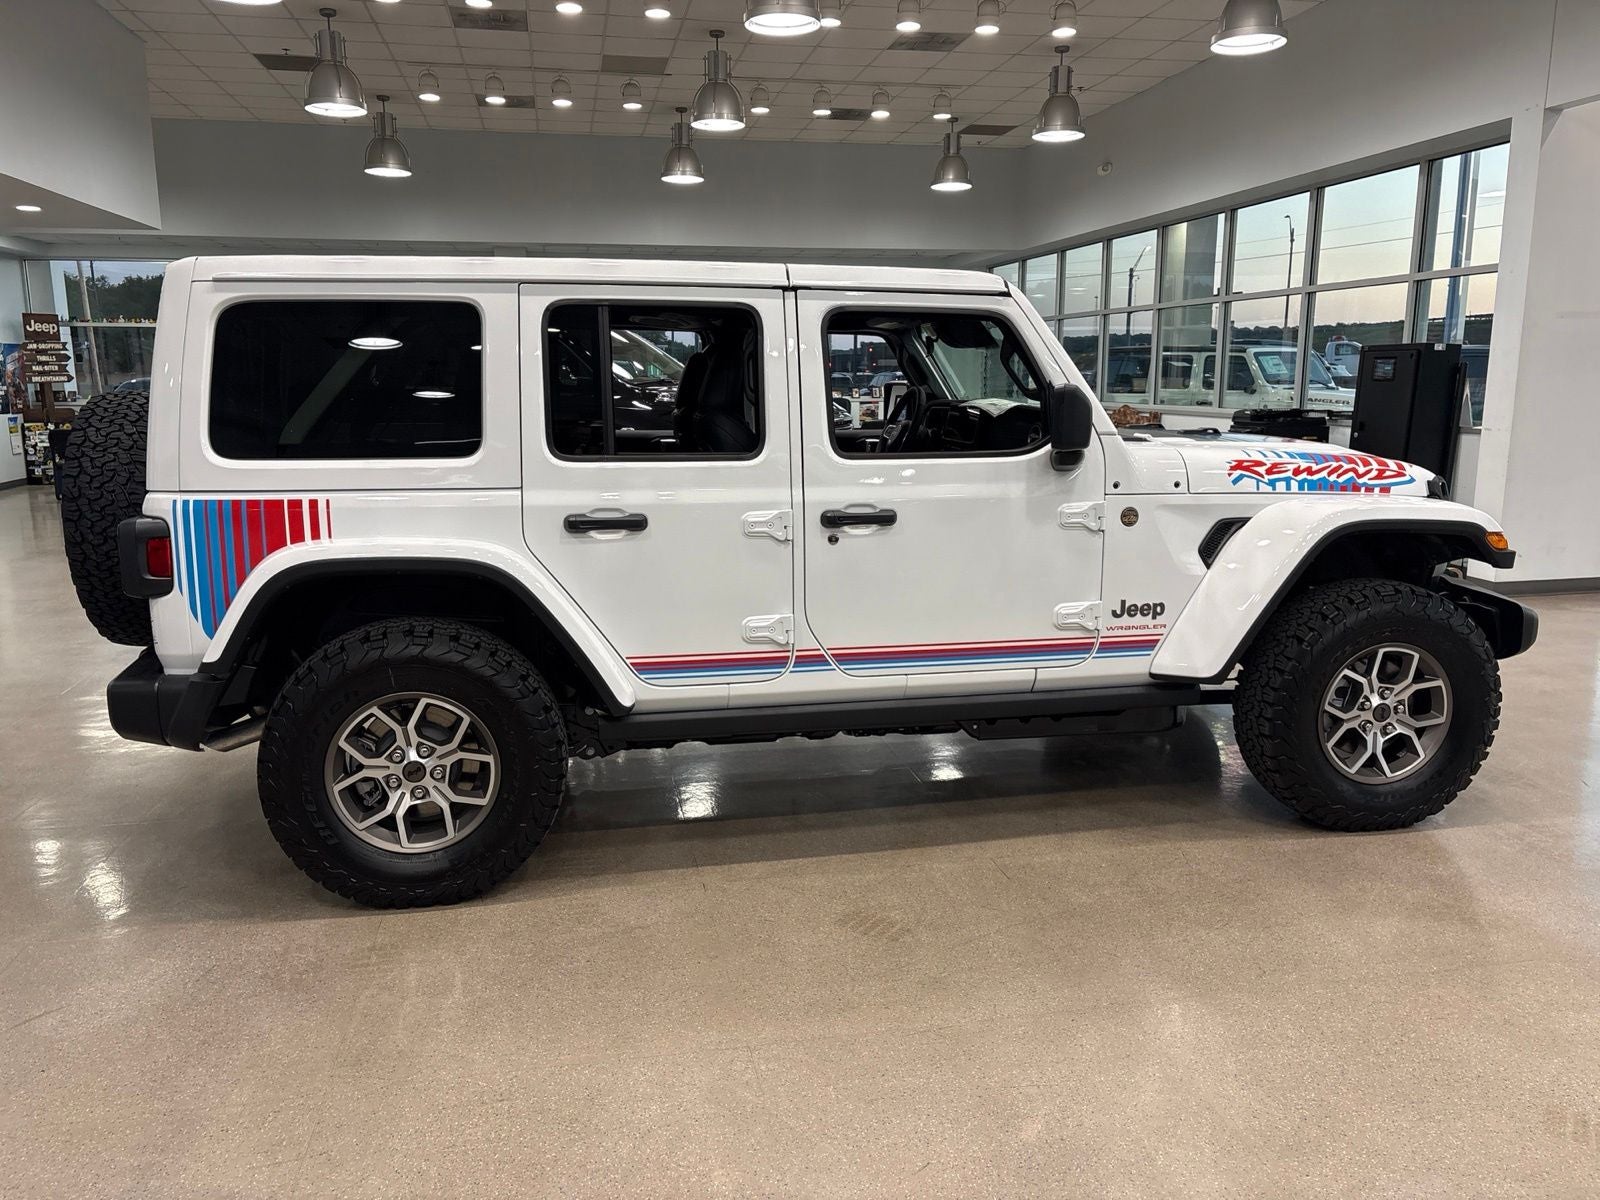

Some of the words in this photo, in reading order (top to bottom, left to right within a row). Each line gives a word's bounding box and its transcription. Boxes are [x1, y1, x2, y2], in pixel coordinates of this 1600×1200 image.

[26, 320, 58, 335] Jeep
[1228, 459, 1408, 481] REWIND
[1111, 599, 1166, 620] Jeep
